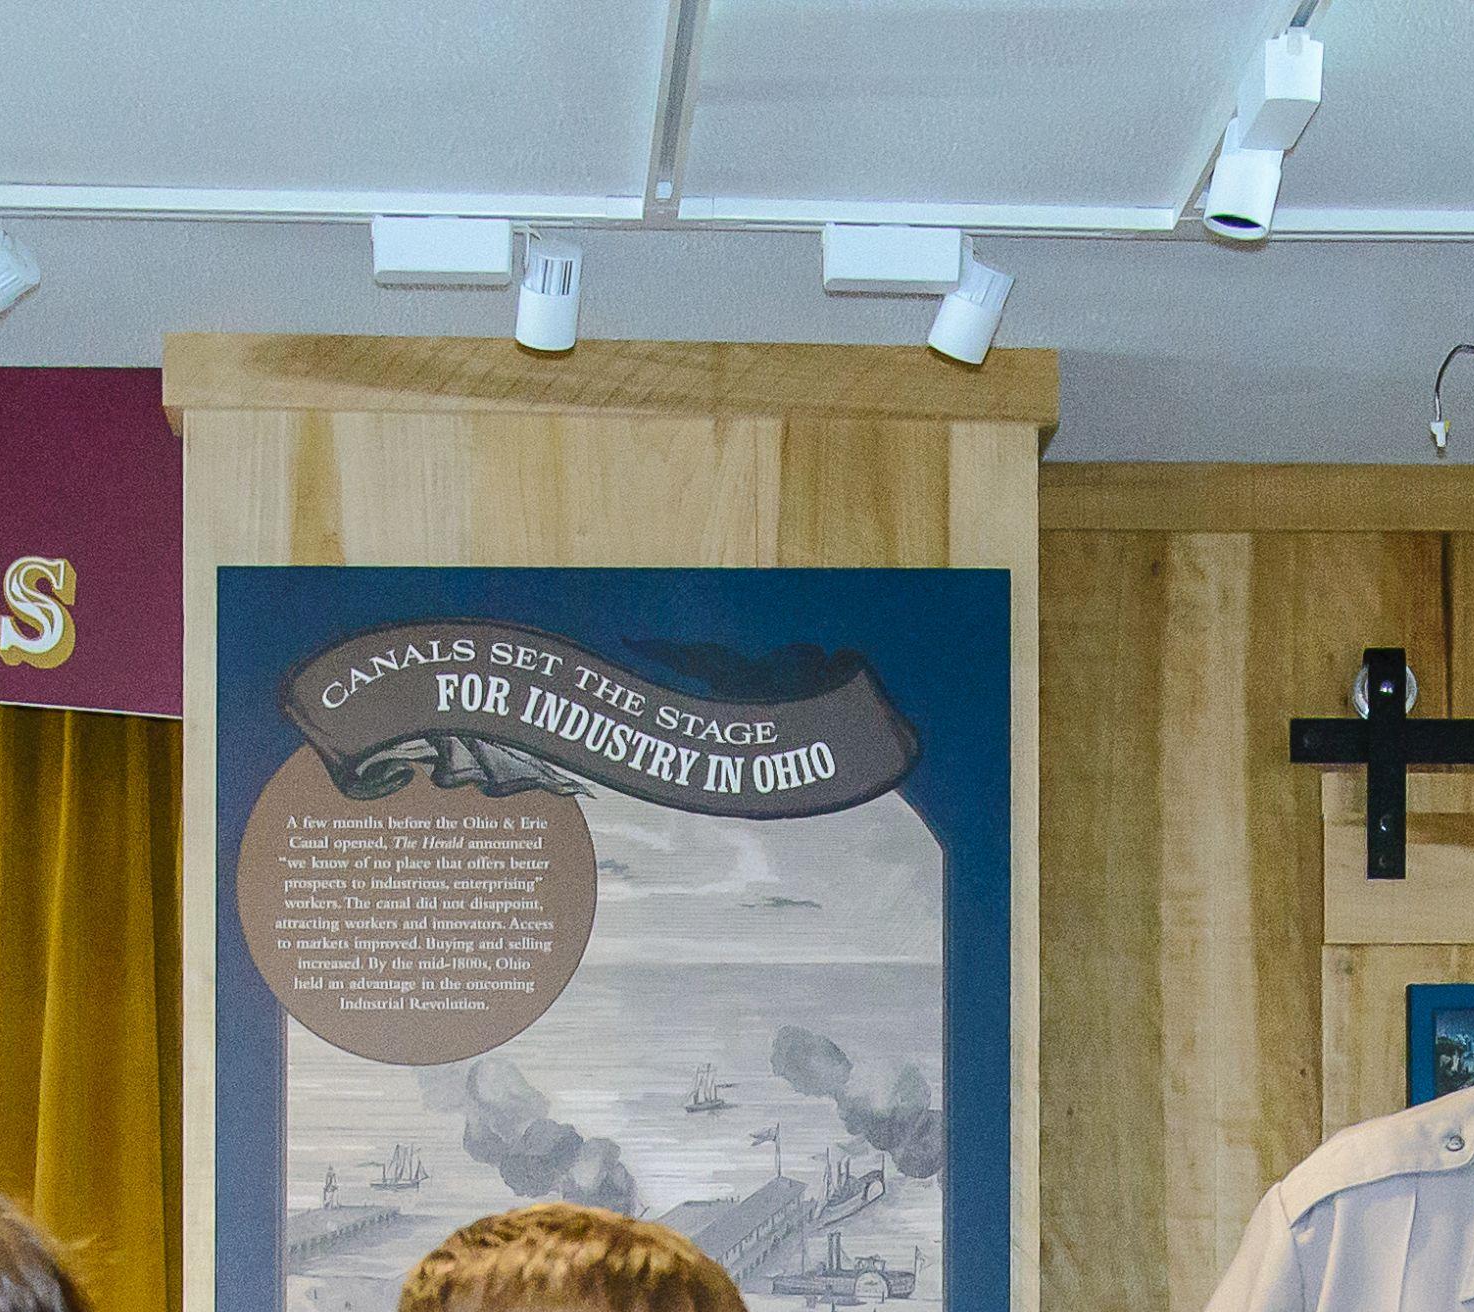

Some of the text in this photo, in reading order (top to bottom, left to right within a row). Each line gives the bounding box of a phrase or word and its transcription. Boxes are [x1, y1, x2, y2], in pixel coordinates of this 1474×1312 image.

[322, 639, 779, 745] CANALS SET THE STAGE
[435, 673, 836, 794] FOR INDUSTRY IN OHIO
[286, 816, 548, 829] A few months before the Ohio & Erie
[289, 837, 542, 852] Canal opened, The Herald announced
[312, 857, 348, 869] know
[355, 857, 371, 869] of
[374, 859, 391, 869] no
[397, 857, 431, 872] place
[436, 857, 461, 869] that
[467, 857, 505, 869] offers
[510, 857, 550, 869] better
[285, 879, 347, 892] prospects
[352, 880, 366, 889] to
[370, 877, 449, 890] industrious,
[285, 897, 543, 913] workers. The canal did not disappoint,
[275, 917, 554, 932] attracting workers and innovators. Access
[277, 937, 552, 953] to markets improved. Buying and selling
[298, 957, 363, 970] increased.
[368, 957, 386, 973] By
[392, 957, 413, 970] the
[495, 957, 530, 970] Ohio
[294, 977, 535, 993] held an advantage in the oncoming
[340, 997, 489, 1011] Industrial Revolution.
